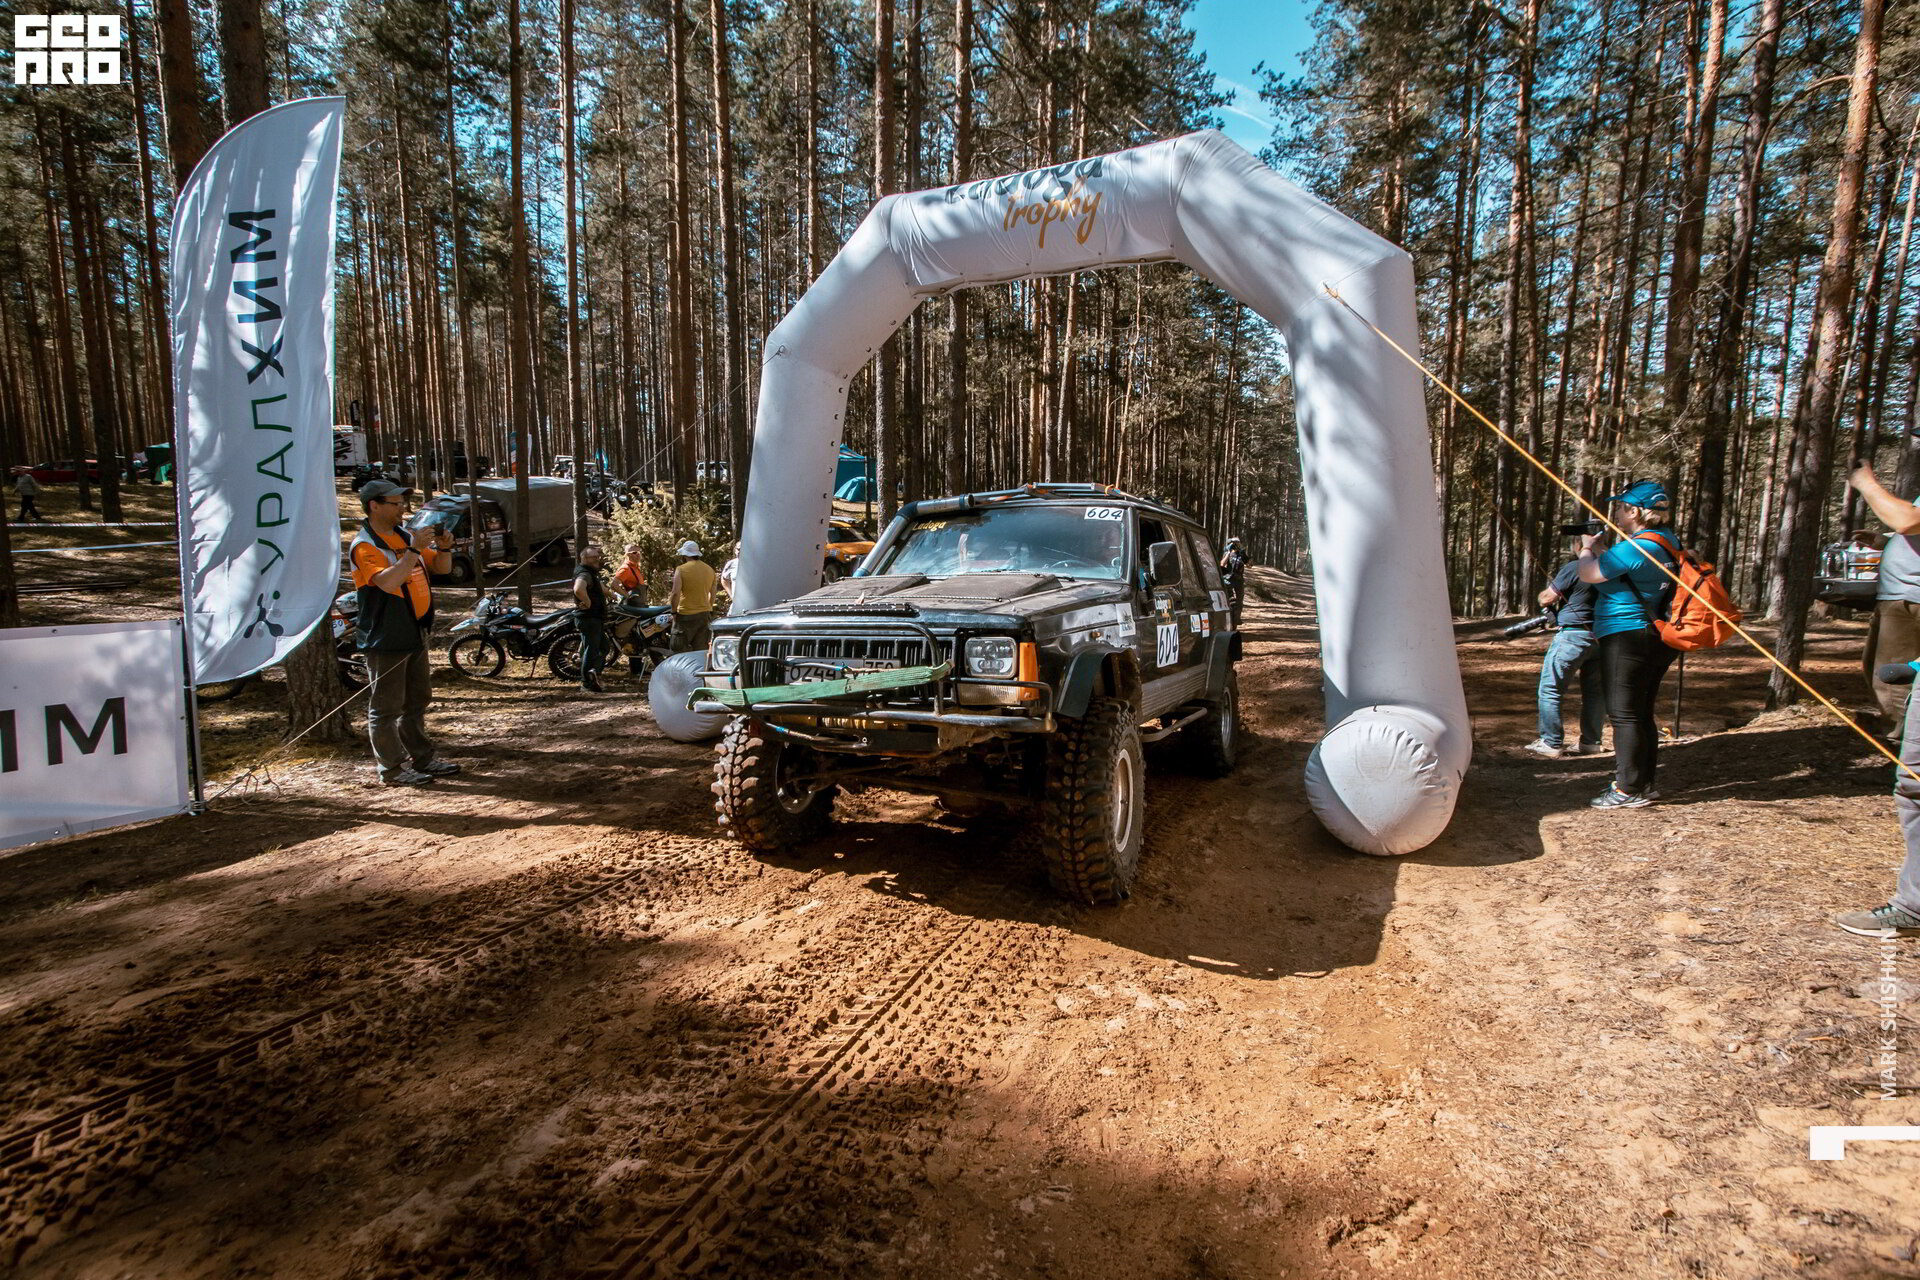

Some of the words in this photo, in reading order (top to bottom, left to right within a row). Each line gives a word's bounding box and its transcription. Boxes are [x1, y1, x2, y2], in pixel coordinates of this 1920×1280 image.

[228, 208, 294, 575] УРАЛХИМ
[911, 520, 947, 532] Ladoga
[1086, 508, 1123, 520] 604
[1158, 625, 1178, 665] 604
